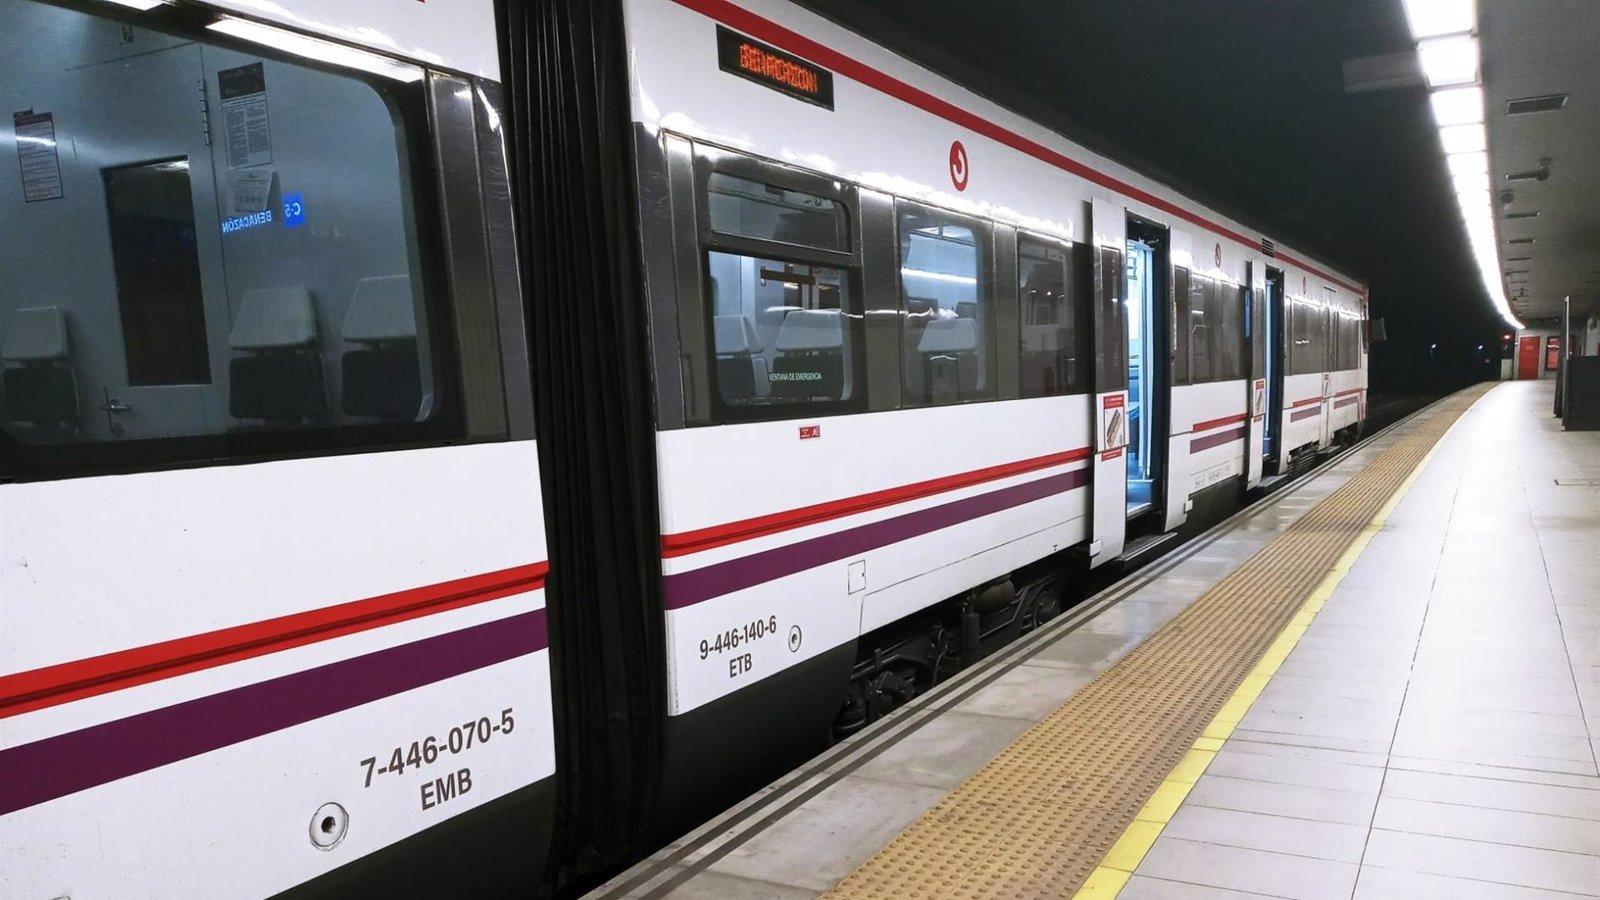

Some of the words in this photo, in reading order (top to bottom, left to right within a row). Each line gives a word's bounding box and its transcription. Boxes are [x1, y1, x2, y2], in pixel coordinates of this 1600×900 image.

[769, 373, 788, 381] VENTANA
[789, 372, 795, 381] DE
[700, 615, 777, 660] 9-446-140-6
[729, 653, 752, 678] ETB
[360, 707, 515, 788] 7-446-070-5
[420, 767, 473, 811] EMB
